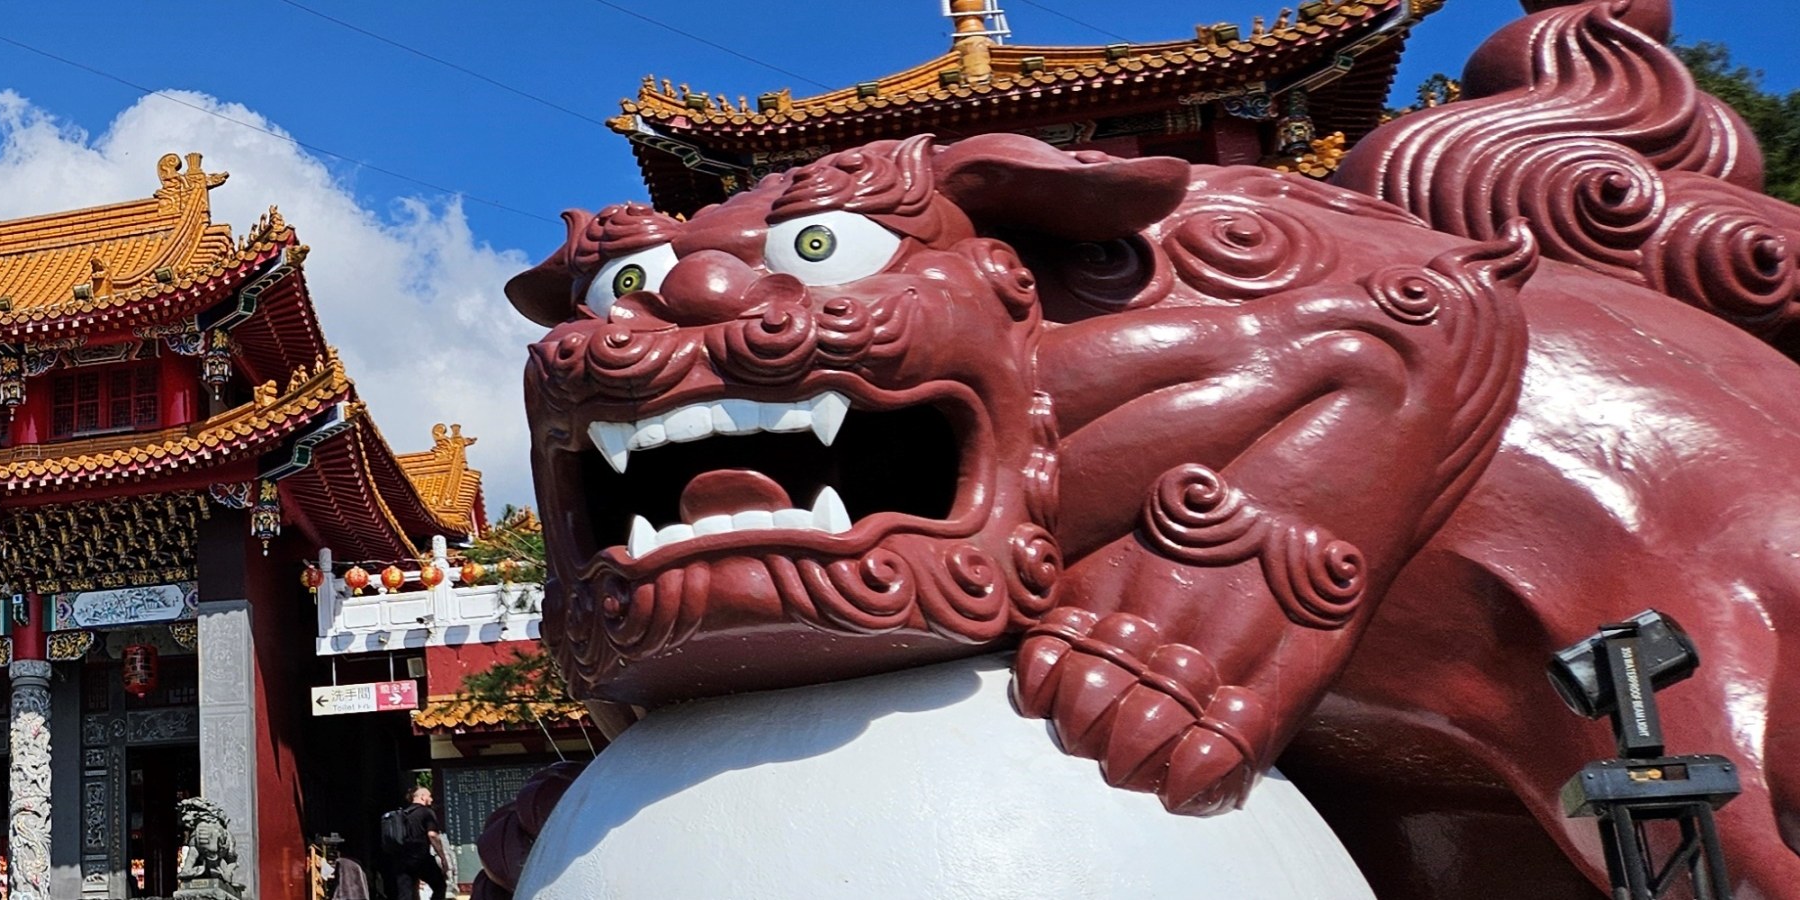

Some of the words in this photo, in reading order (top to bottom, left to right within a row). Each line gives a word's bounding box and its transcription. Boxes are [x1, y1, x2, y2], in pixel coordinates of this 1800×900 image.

[1624, 658, 1642, 700] WATERPROOF
[331, 687, 371, 702] 洗手間
[333, 704, 355, 713] Toilet
[1632, 701, 1646, 718] BEAM
[1636, 719, 1650, 736] LIGHT
